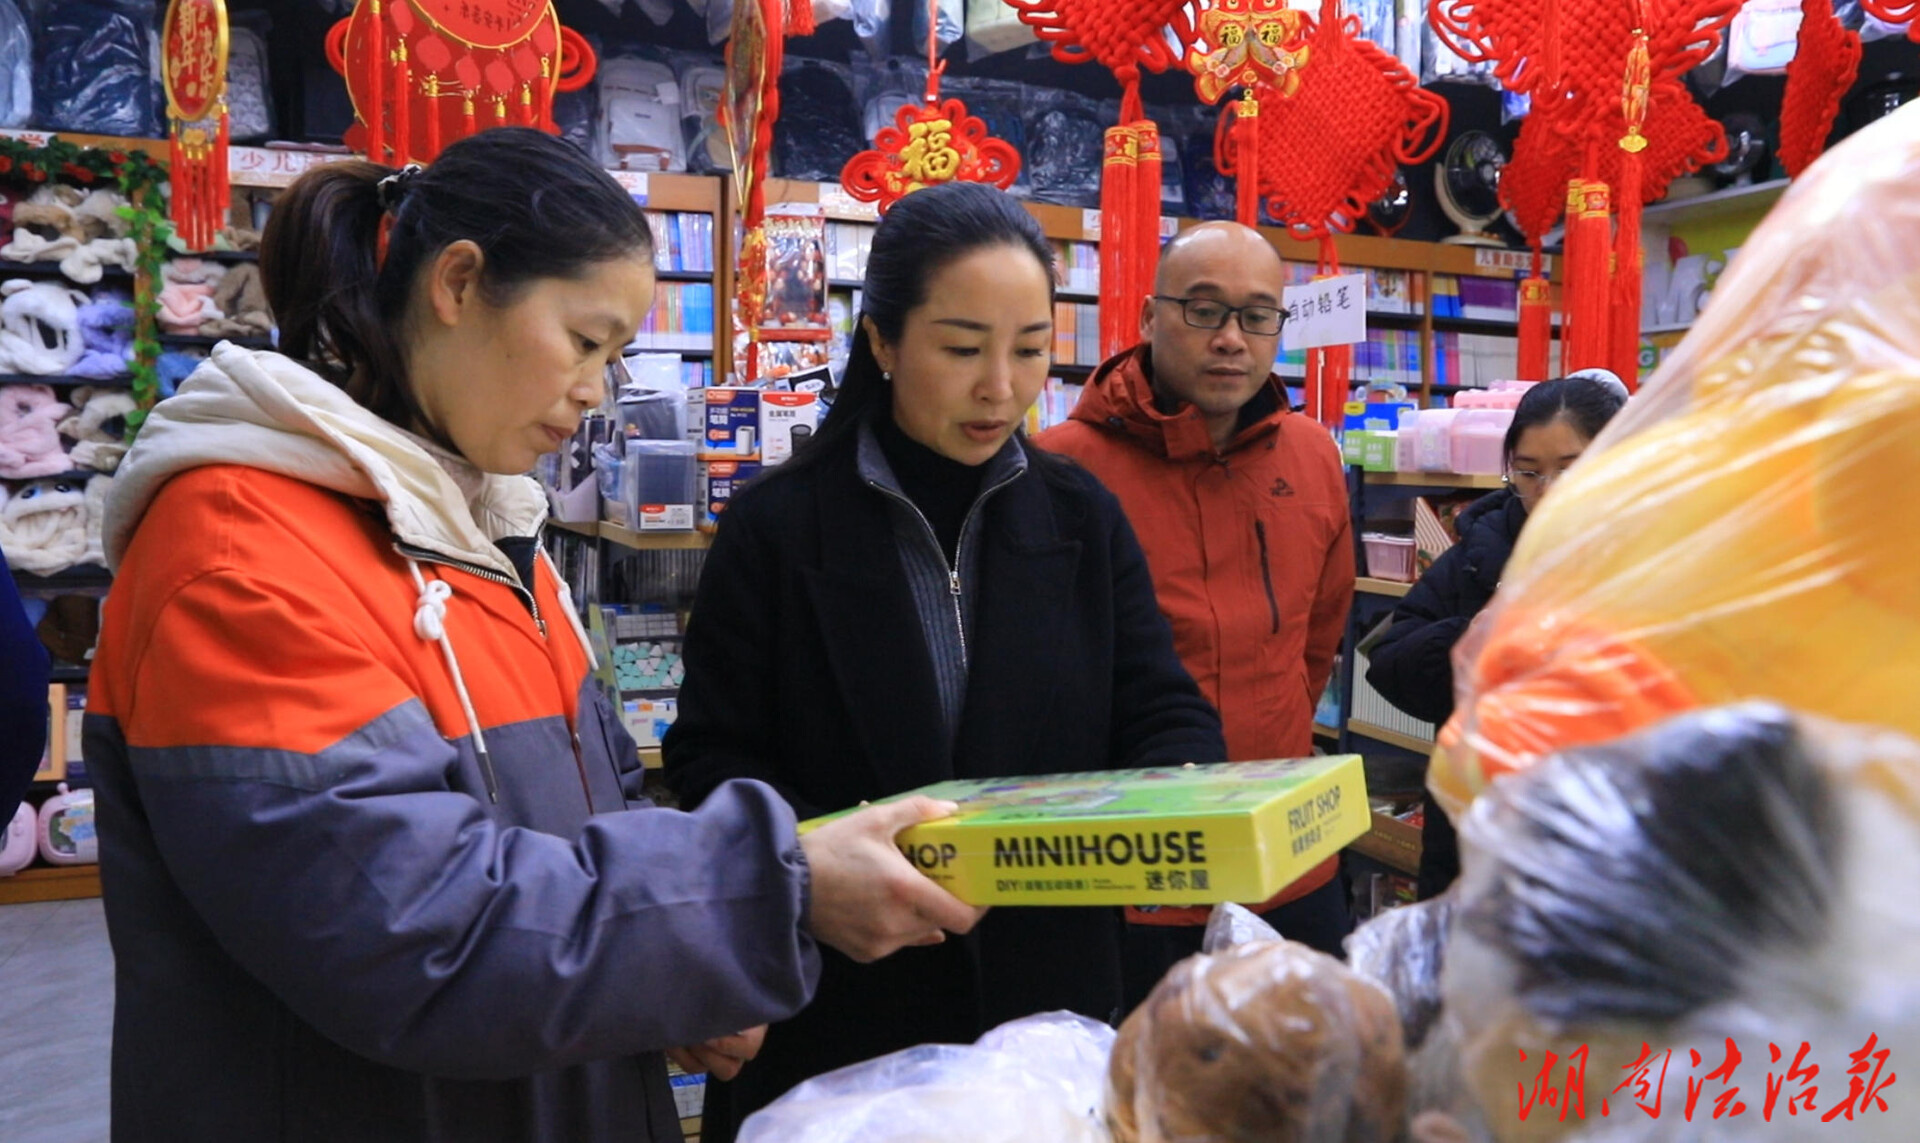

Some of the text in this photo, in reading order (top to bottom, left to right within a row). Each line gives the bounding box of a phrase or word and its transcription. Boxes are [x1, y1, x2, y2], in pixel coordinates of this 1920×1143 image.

[1220, 25, 1241, 44] 福
[1260, 24, 1281, 44] 福
[900, 119, 960, 182] 福
[1288, 285, 1351, 324] 自动铅笔
[1287, 799, 1316, 836] FRUIT
[1316, 785, 1341, 819] SHOP
[993, 831, 1207, 868] MINIHOUSE
[1145, 869, 1209, 892] 迷你屋
